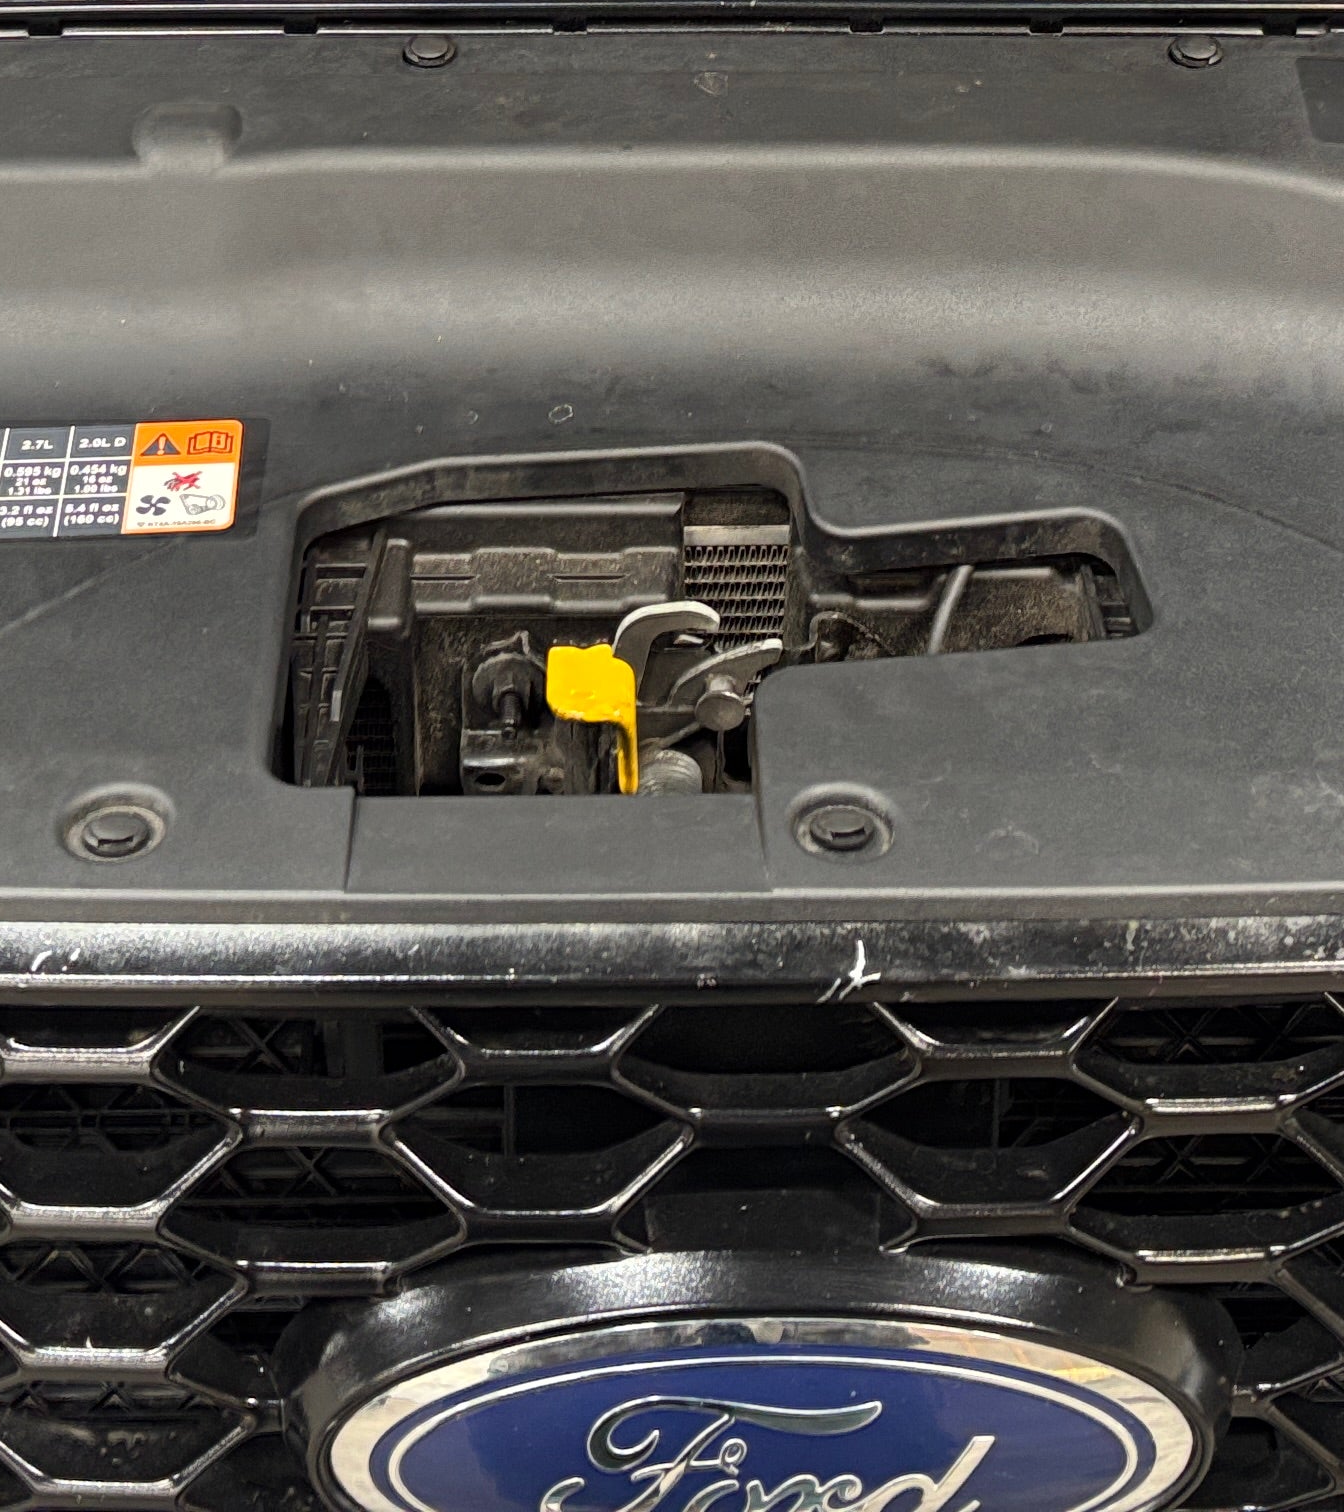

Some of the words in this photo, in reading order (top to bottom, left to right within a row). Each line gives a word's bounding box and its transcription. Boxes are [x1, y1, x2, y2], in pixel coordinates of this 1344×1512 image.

[21, 439, 54, 450] 2.7L
[78, 437, 111, 449] 2.0L
[114, 436, 127, 447] D
[43, 465, 62, 478] kg
[69, 464, 107, 476] 0.454
[109, 463, 127, 476] kg
[15, 477, 29, 486] 21
[31, 477, 47, 486] oz
[82, 475, 96, 484] 16
[98, 475, 113, 484] oz
[35, 505, 54, 515] oz
[64, 503, 87, 514] 5.4
[101, 503, 120, 512] oz
[1, 516, 24, 529] (95
[26, 515, 50, 528] cc)
[96, 513, 120, 525] cc)
[540, 1396, 996, 1512] Ford
